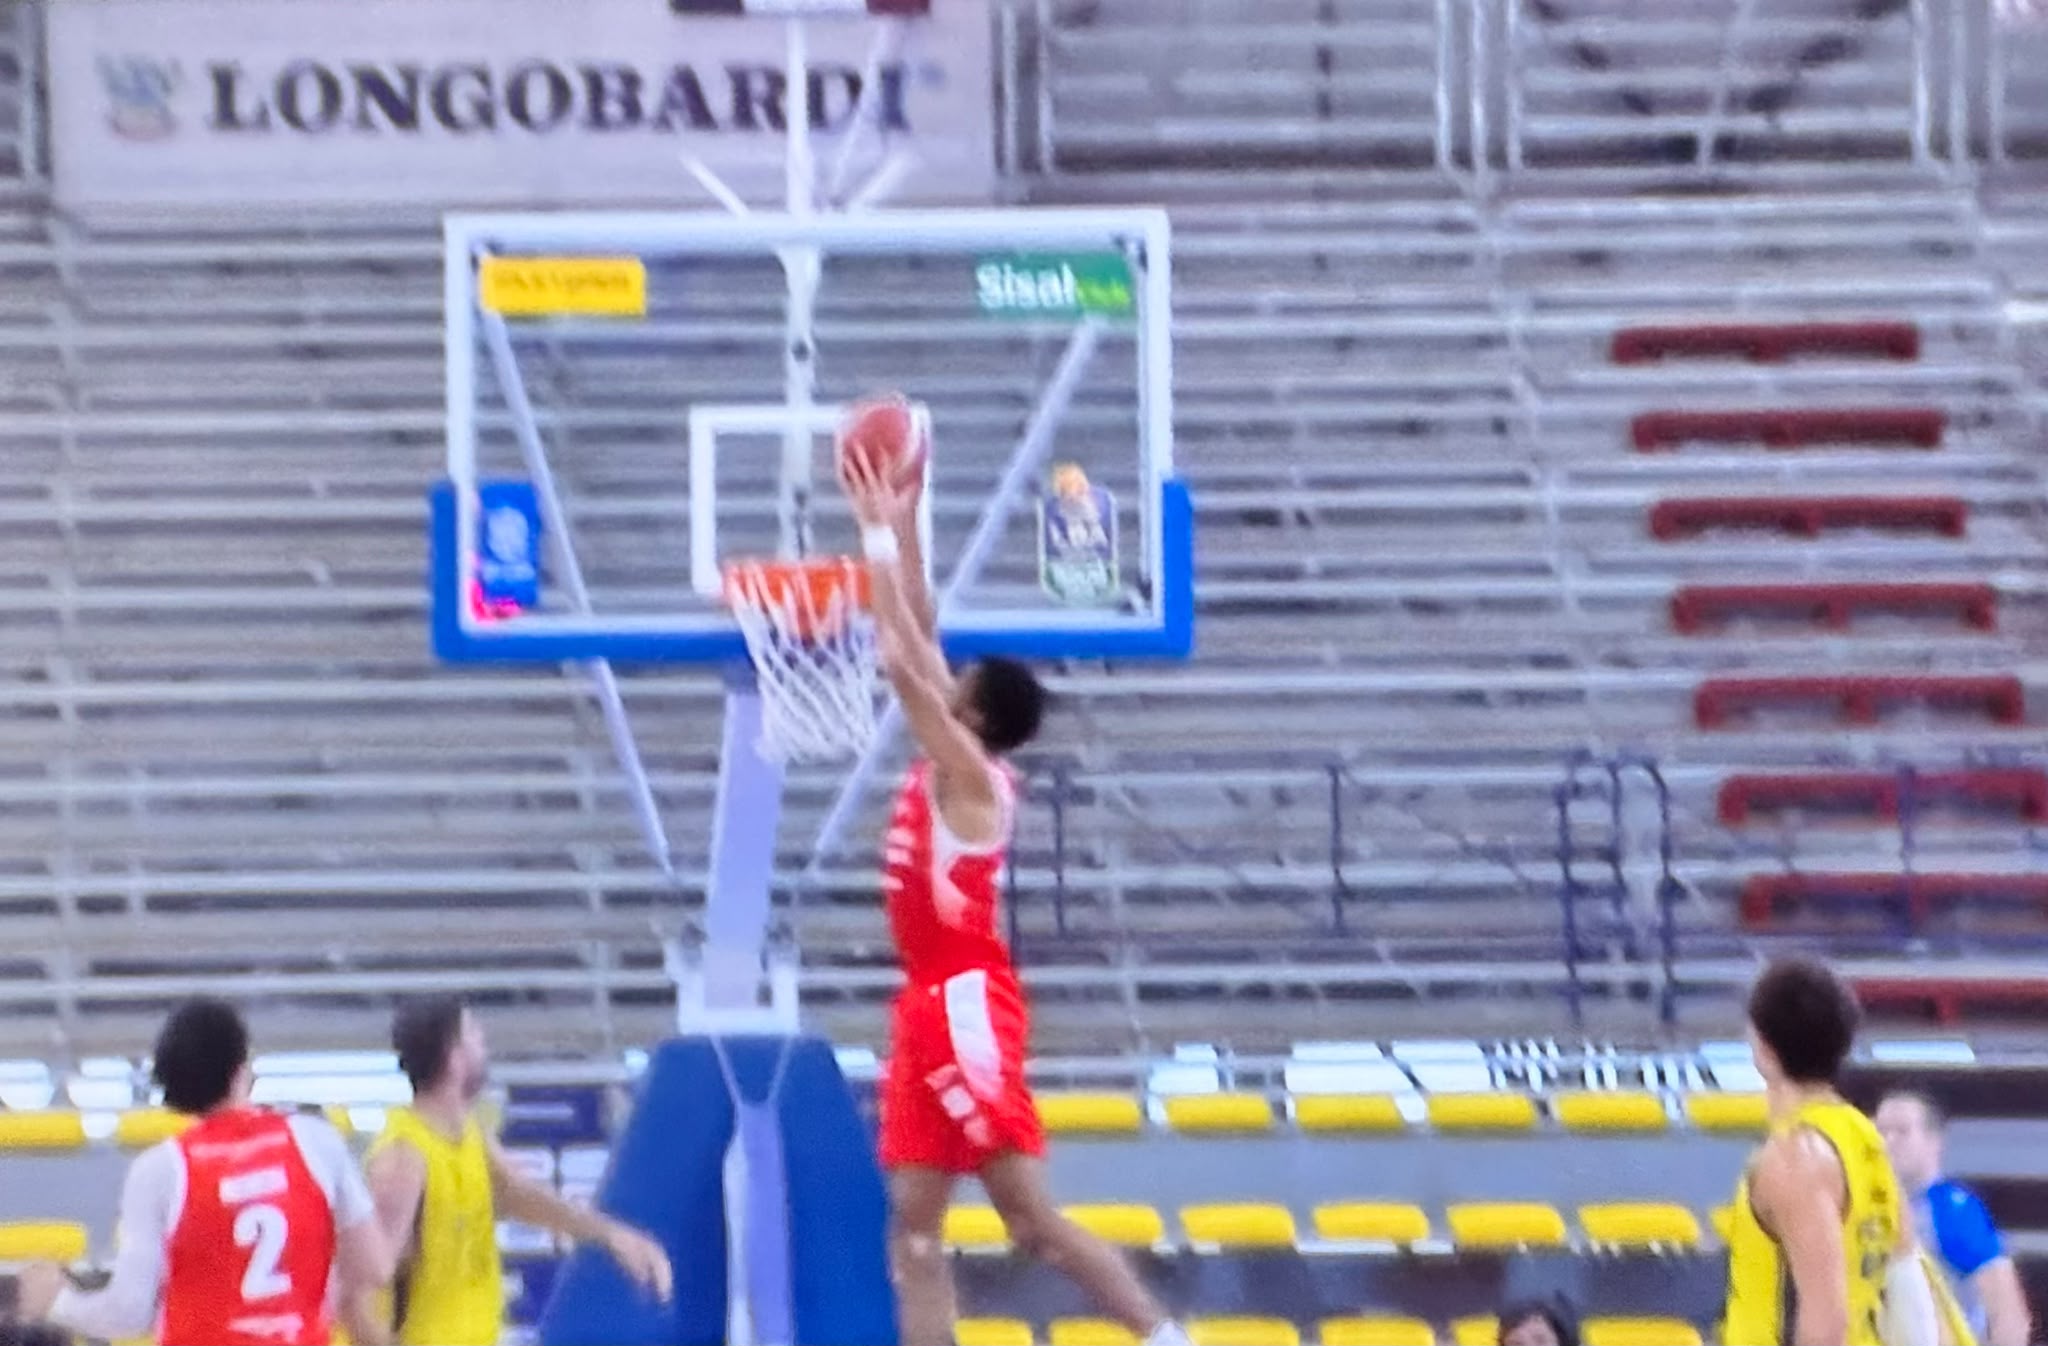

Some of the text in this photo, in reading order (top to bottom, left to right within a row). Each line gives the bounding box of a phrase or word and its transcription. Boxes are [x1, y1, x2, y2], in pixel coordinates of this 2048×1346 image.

[206, 59, 911, 132] LONGOBARDI
[976, 262, 1076, 309] Sisal
[233, 1202, 292, 1304] 2
